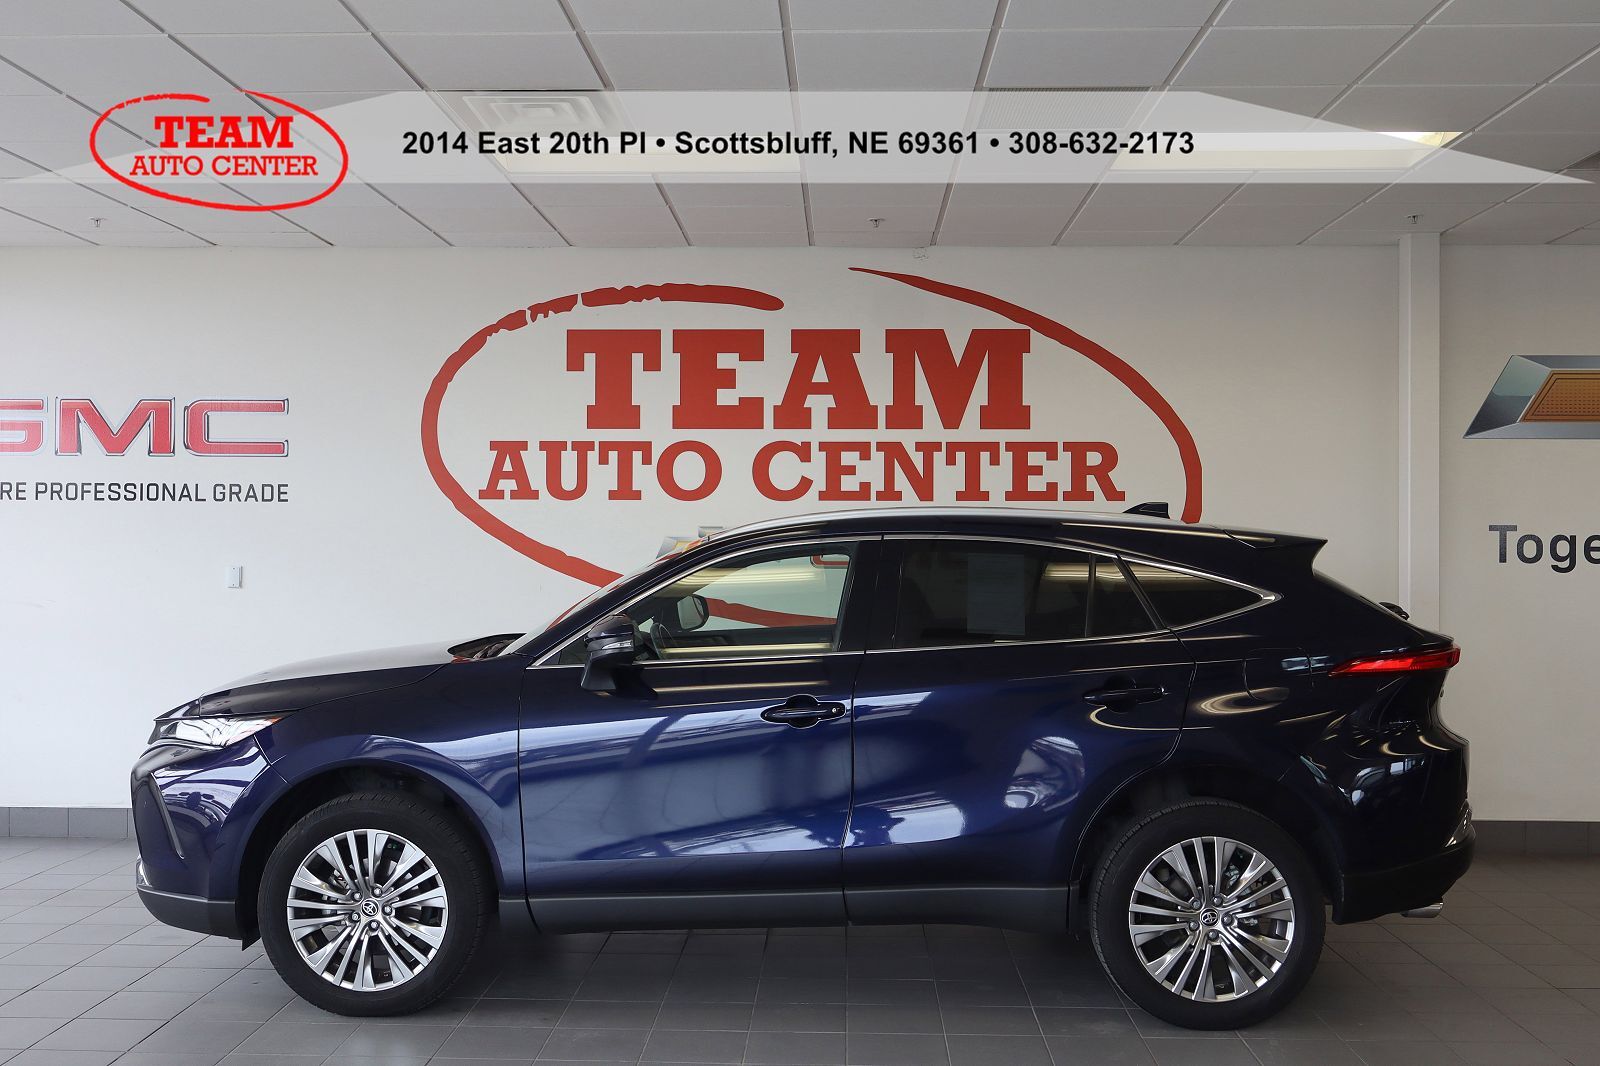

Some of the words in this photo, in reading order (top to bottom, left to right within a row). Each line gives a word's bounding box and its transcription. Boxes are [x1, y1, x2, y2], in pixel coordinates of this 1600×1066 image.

[566, 329, 1031, 429] TEAM
[35, 482, 207, 502] PROFESSIONAL
[212, 483, 289, 503] GRADE
[478, 441, 722, 502] AUTO
[753, 441, 1126, 502] CENTER
